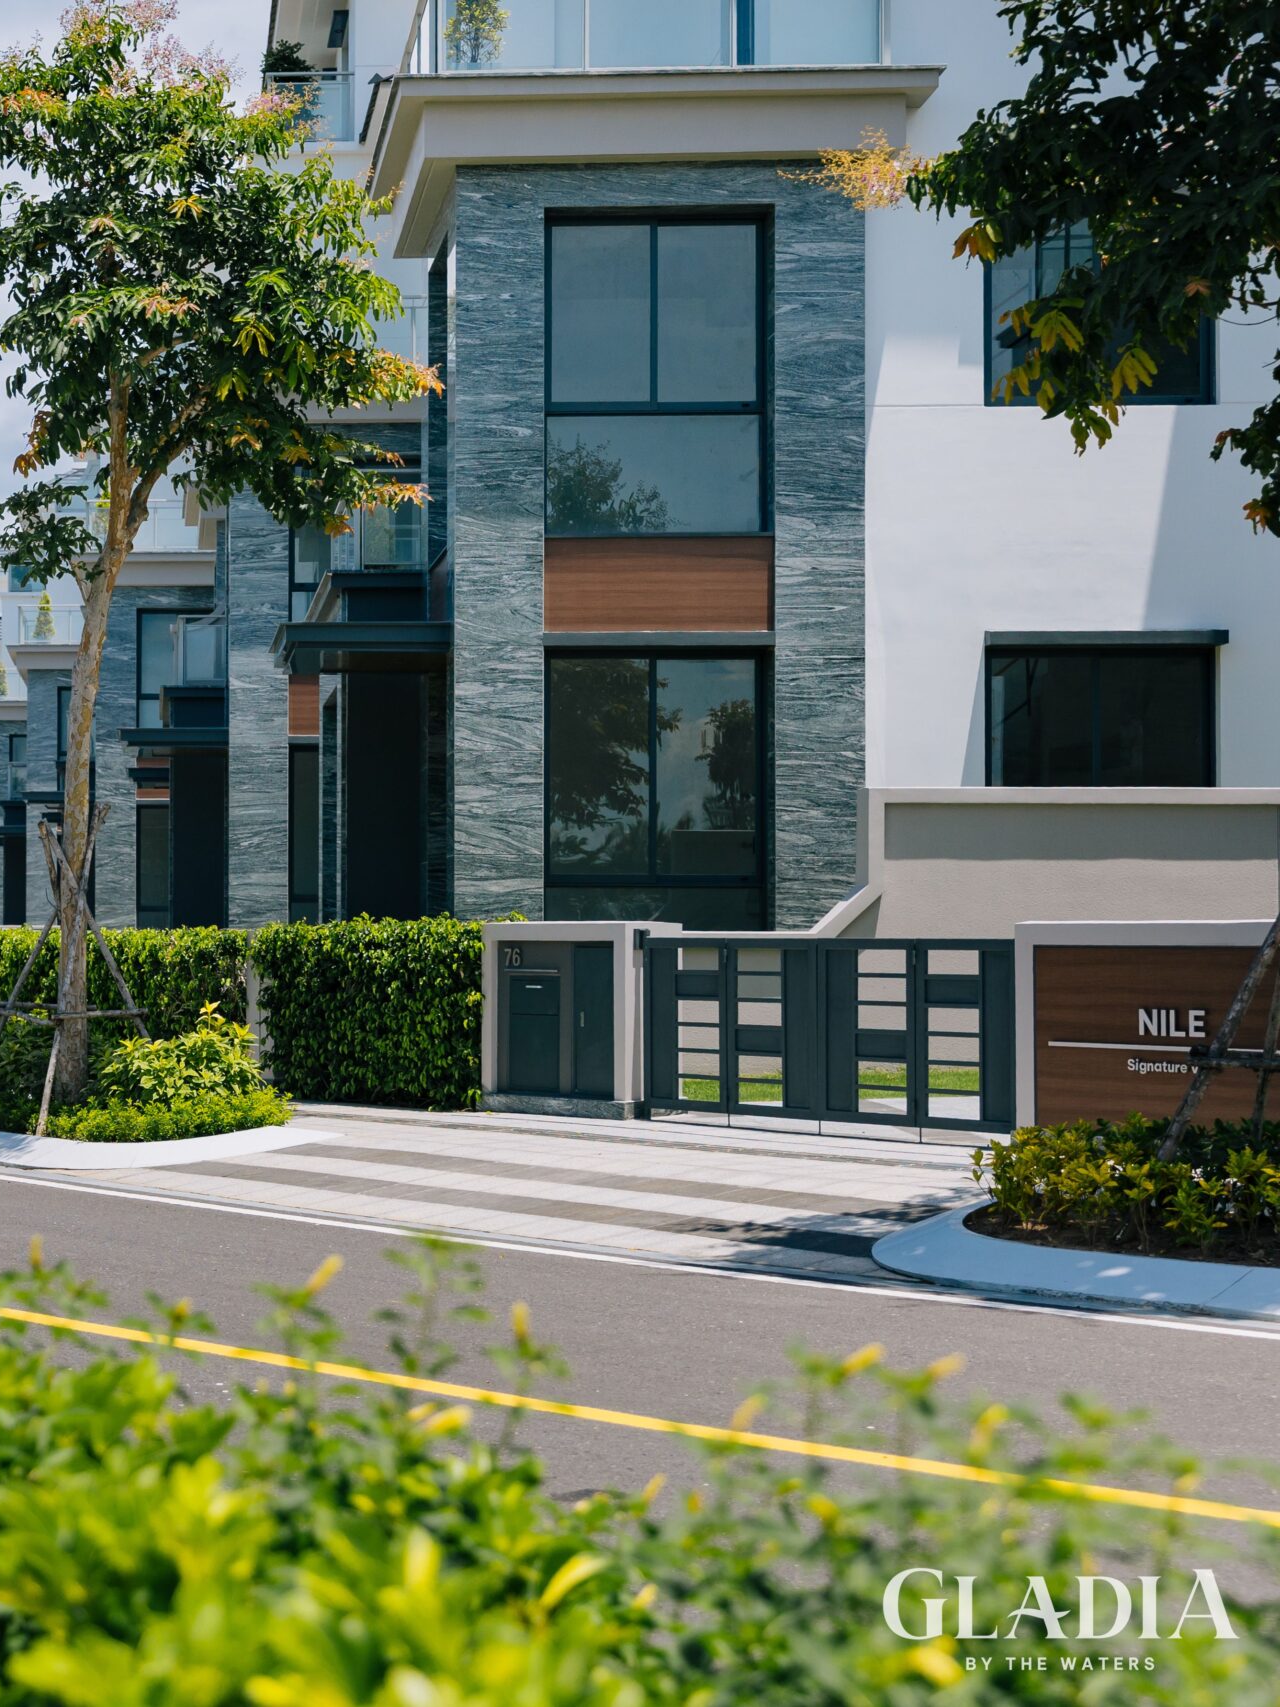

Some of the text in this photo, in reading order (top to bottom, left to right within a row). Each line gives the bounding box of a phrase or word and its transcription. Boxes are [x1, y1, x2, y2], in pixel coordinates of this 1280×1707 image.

[503, 948, 521, 967] 76
[1138, 1008, 1206, 1038] NILE
[1127, 1058, 1188, 1075] Signature
